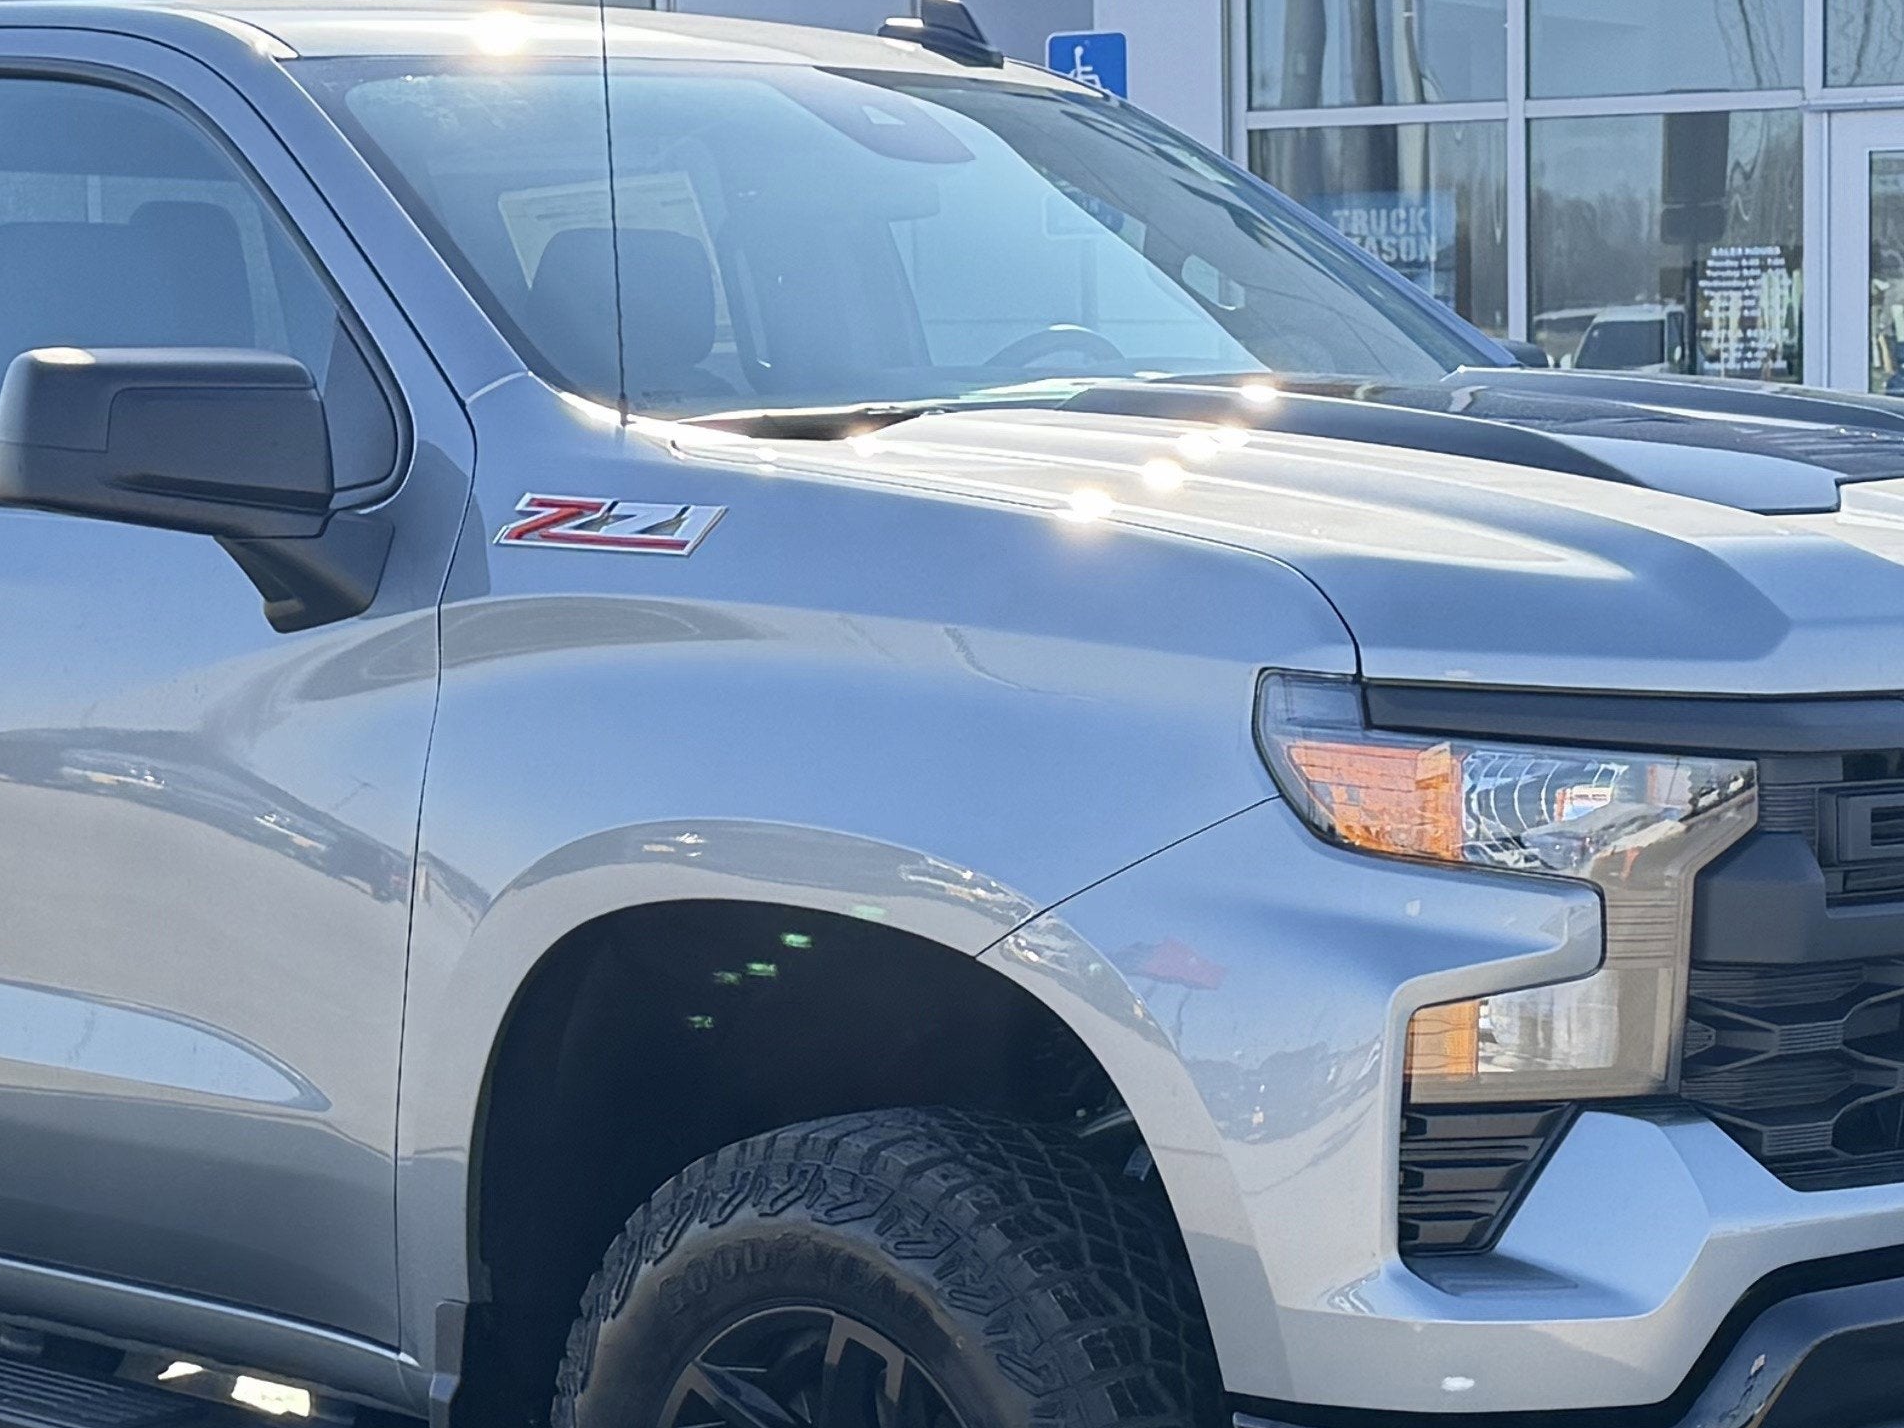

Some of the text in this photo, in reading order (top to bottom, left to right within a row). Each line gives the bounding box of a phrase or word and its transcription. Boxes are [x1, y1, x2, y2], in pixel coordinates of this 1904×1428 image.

[1332, 207, 1427, 235] TRUCK
[1350, 236, 1438, 263] ASON
[493, 492, 729, 557] Z71
